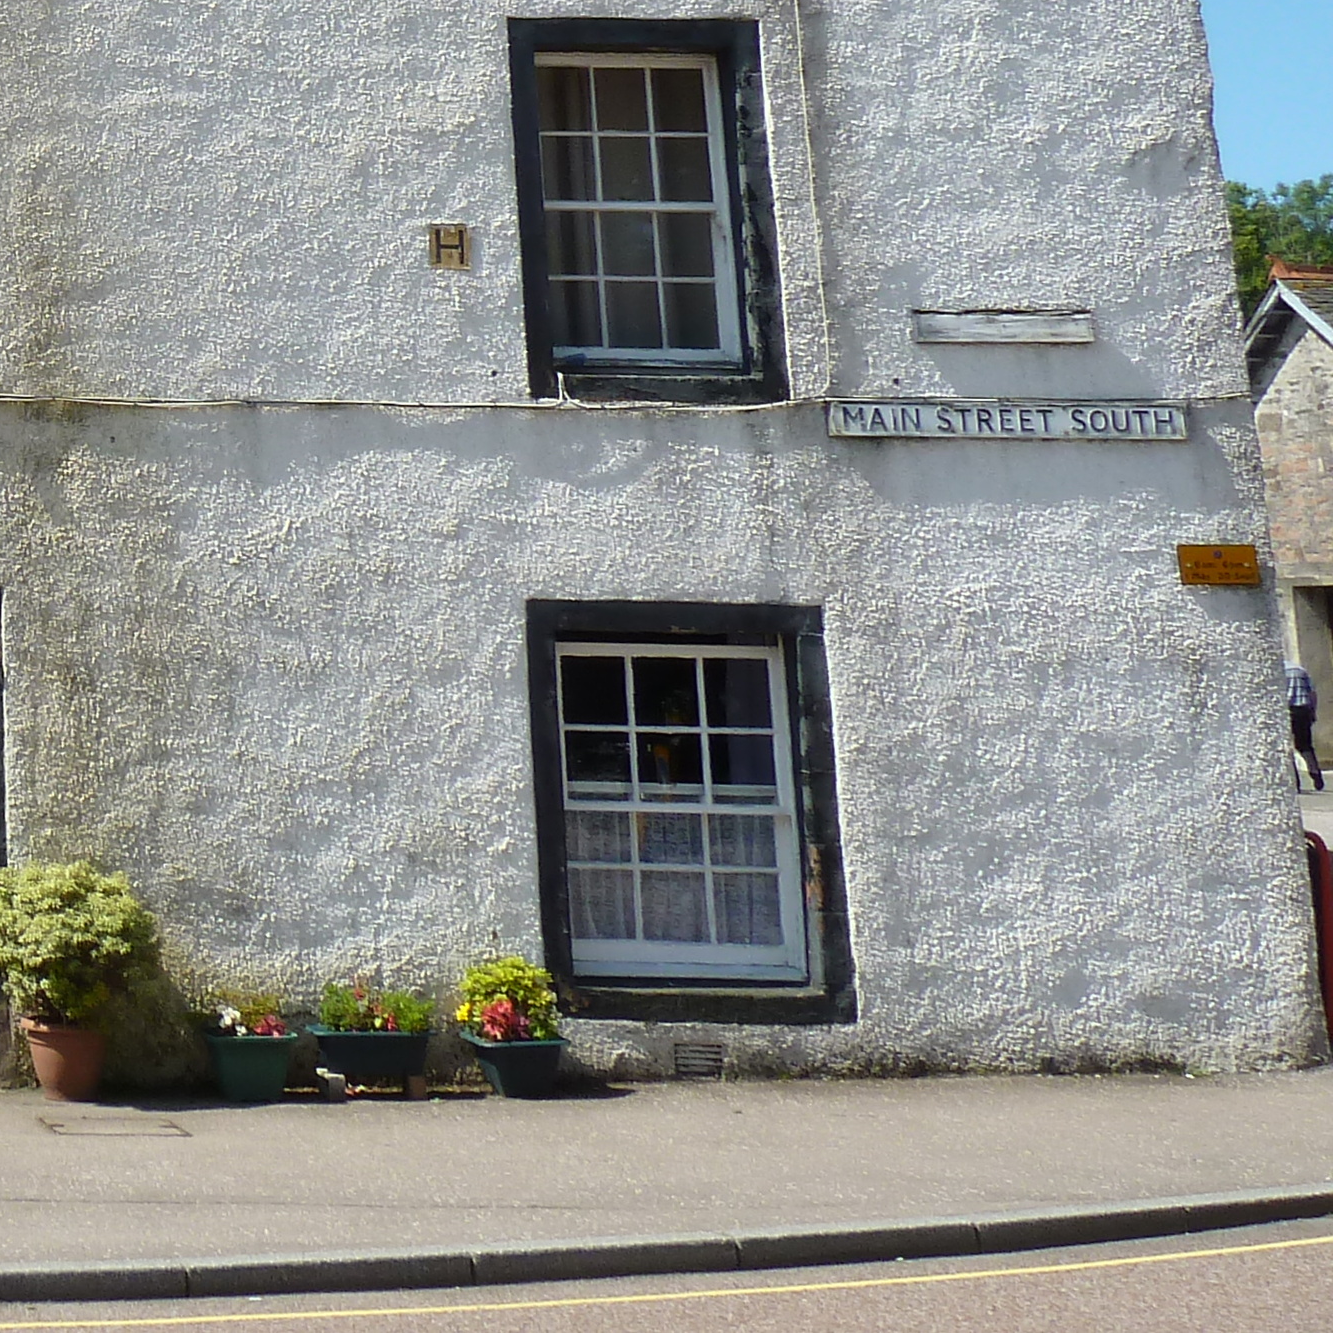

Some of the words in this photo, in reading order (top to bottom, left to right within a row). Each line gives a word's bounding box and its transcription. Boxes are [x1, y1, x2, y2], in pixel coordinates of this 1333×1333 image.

[435, 229, 464, 264] H
[842, 406, 921, 432] MAIN
[937, 407, 1054, 433] STREET
[1071, 409, 1176, 434] SOUTH
